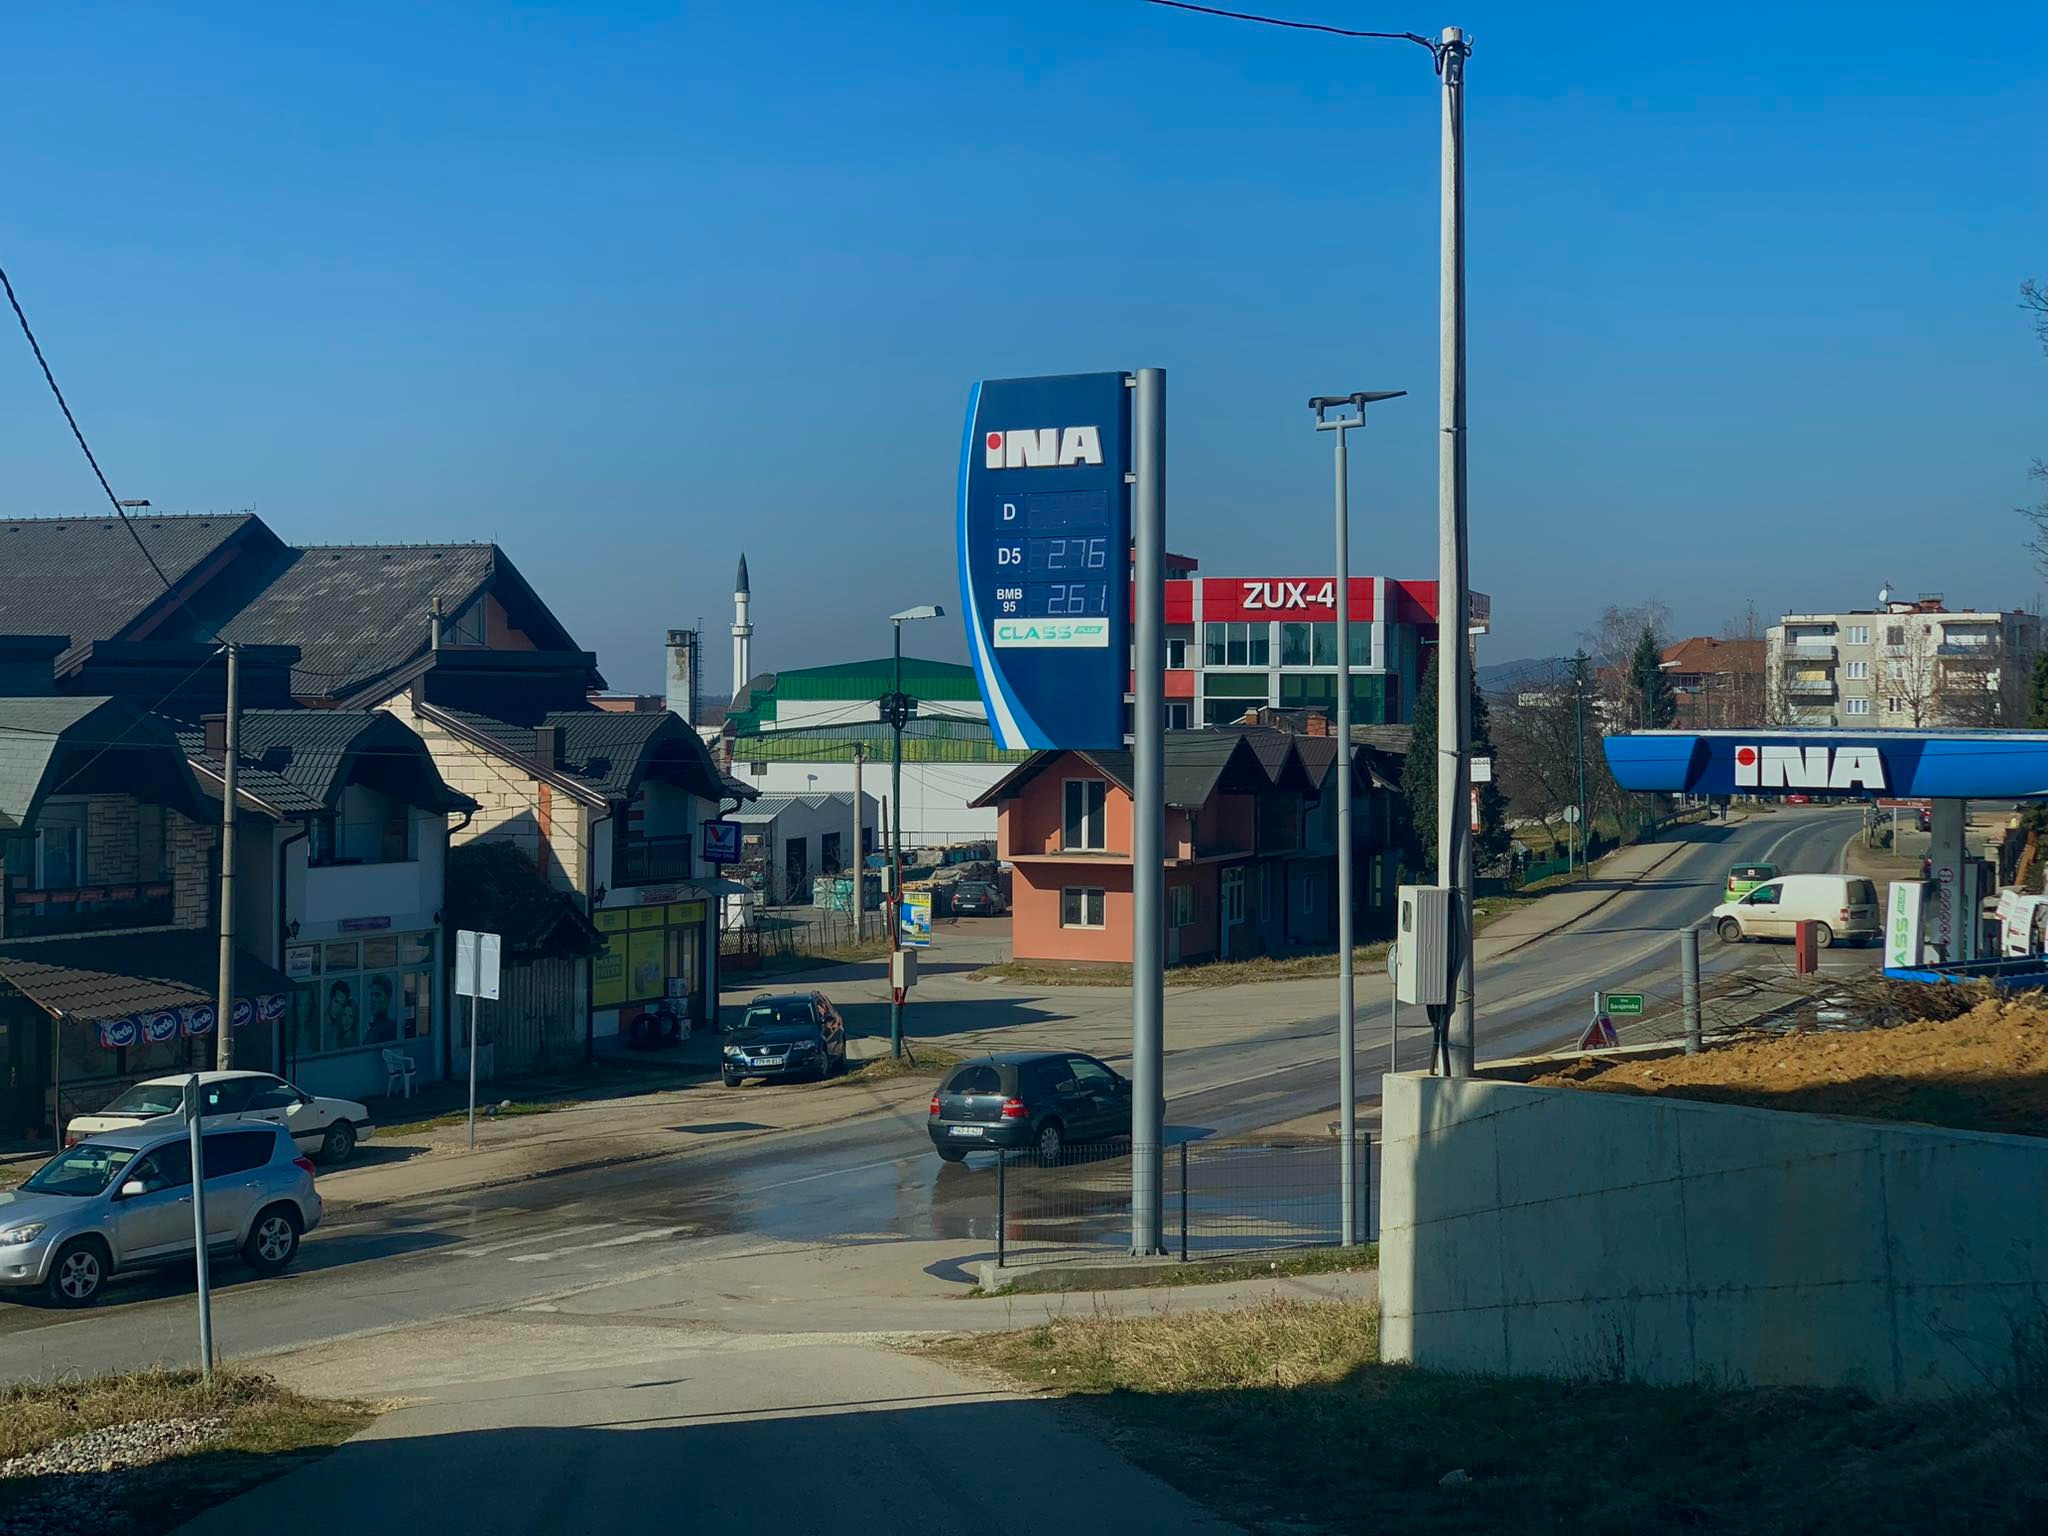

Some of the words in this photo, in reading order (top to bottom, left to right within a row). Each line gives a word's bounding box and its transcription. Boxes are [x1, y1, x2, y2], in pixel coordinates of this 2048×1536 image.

[1002, 503, 1016, 521] D
[997, 547, 1022, 566] D5
[1047, 538, 1107, 570] 2.76
[996, 587, 1023, 600] BMB
[1242, 581, 1335, 609] ZUX-4
[1002, 601, 1017, 613] 95
[998, 625, 1073, 641] CLASS
